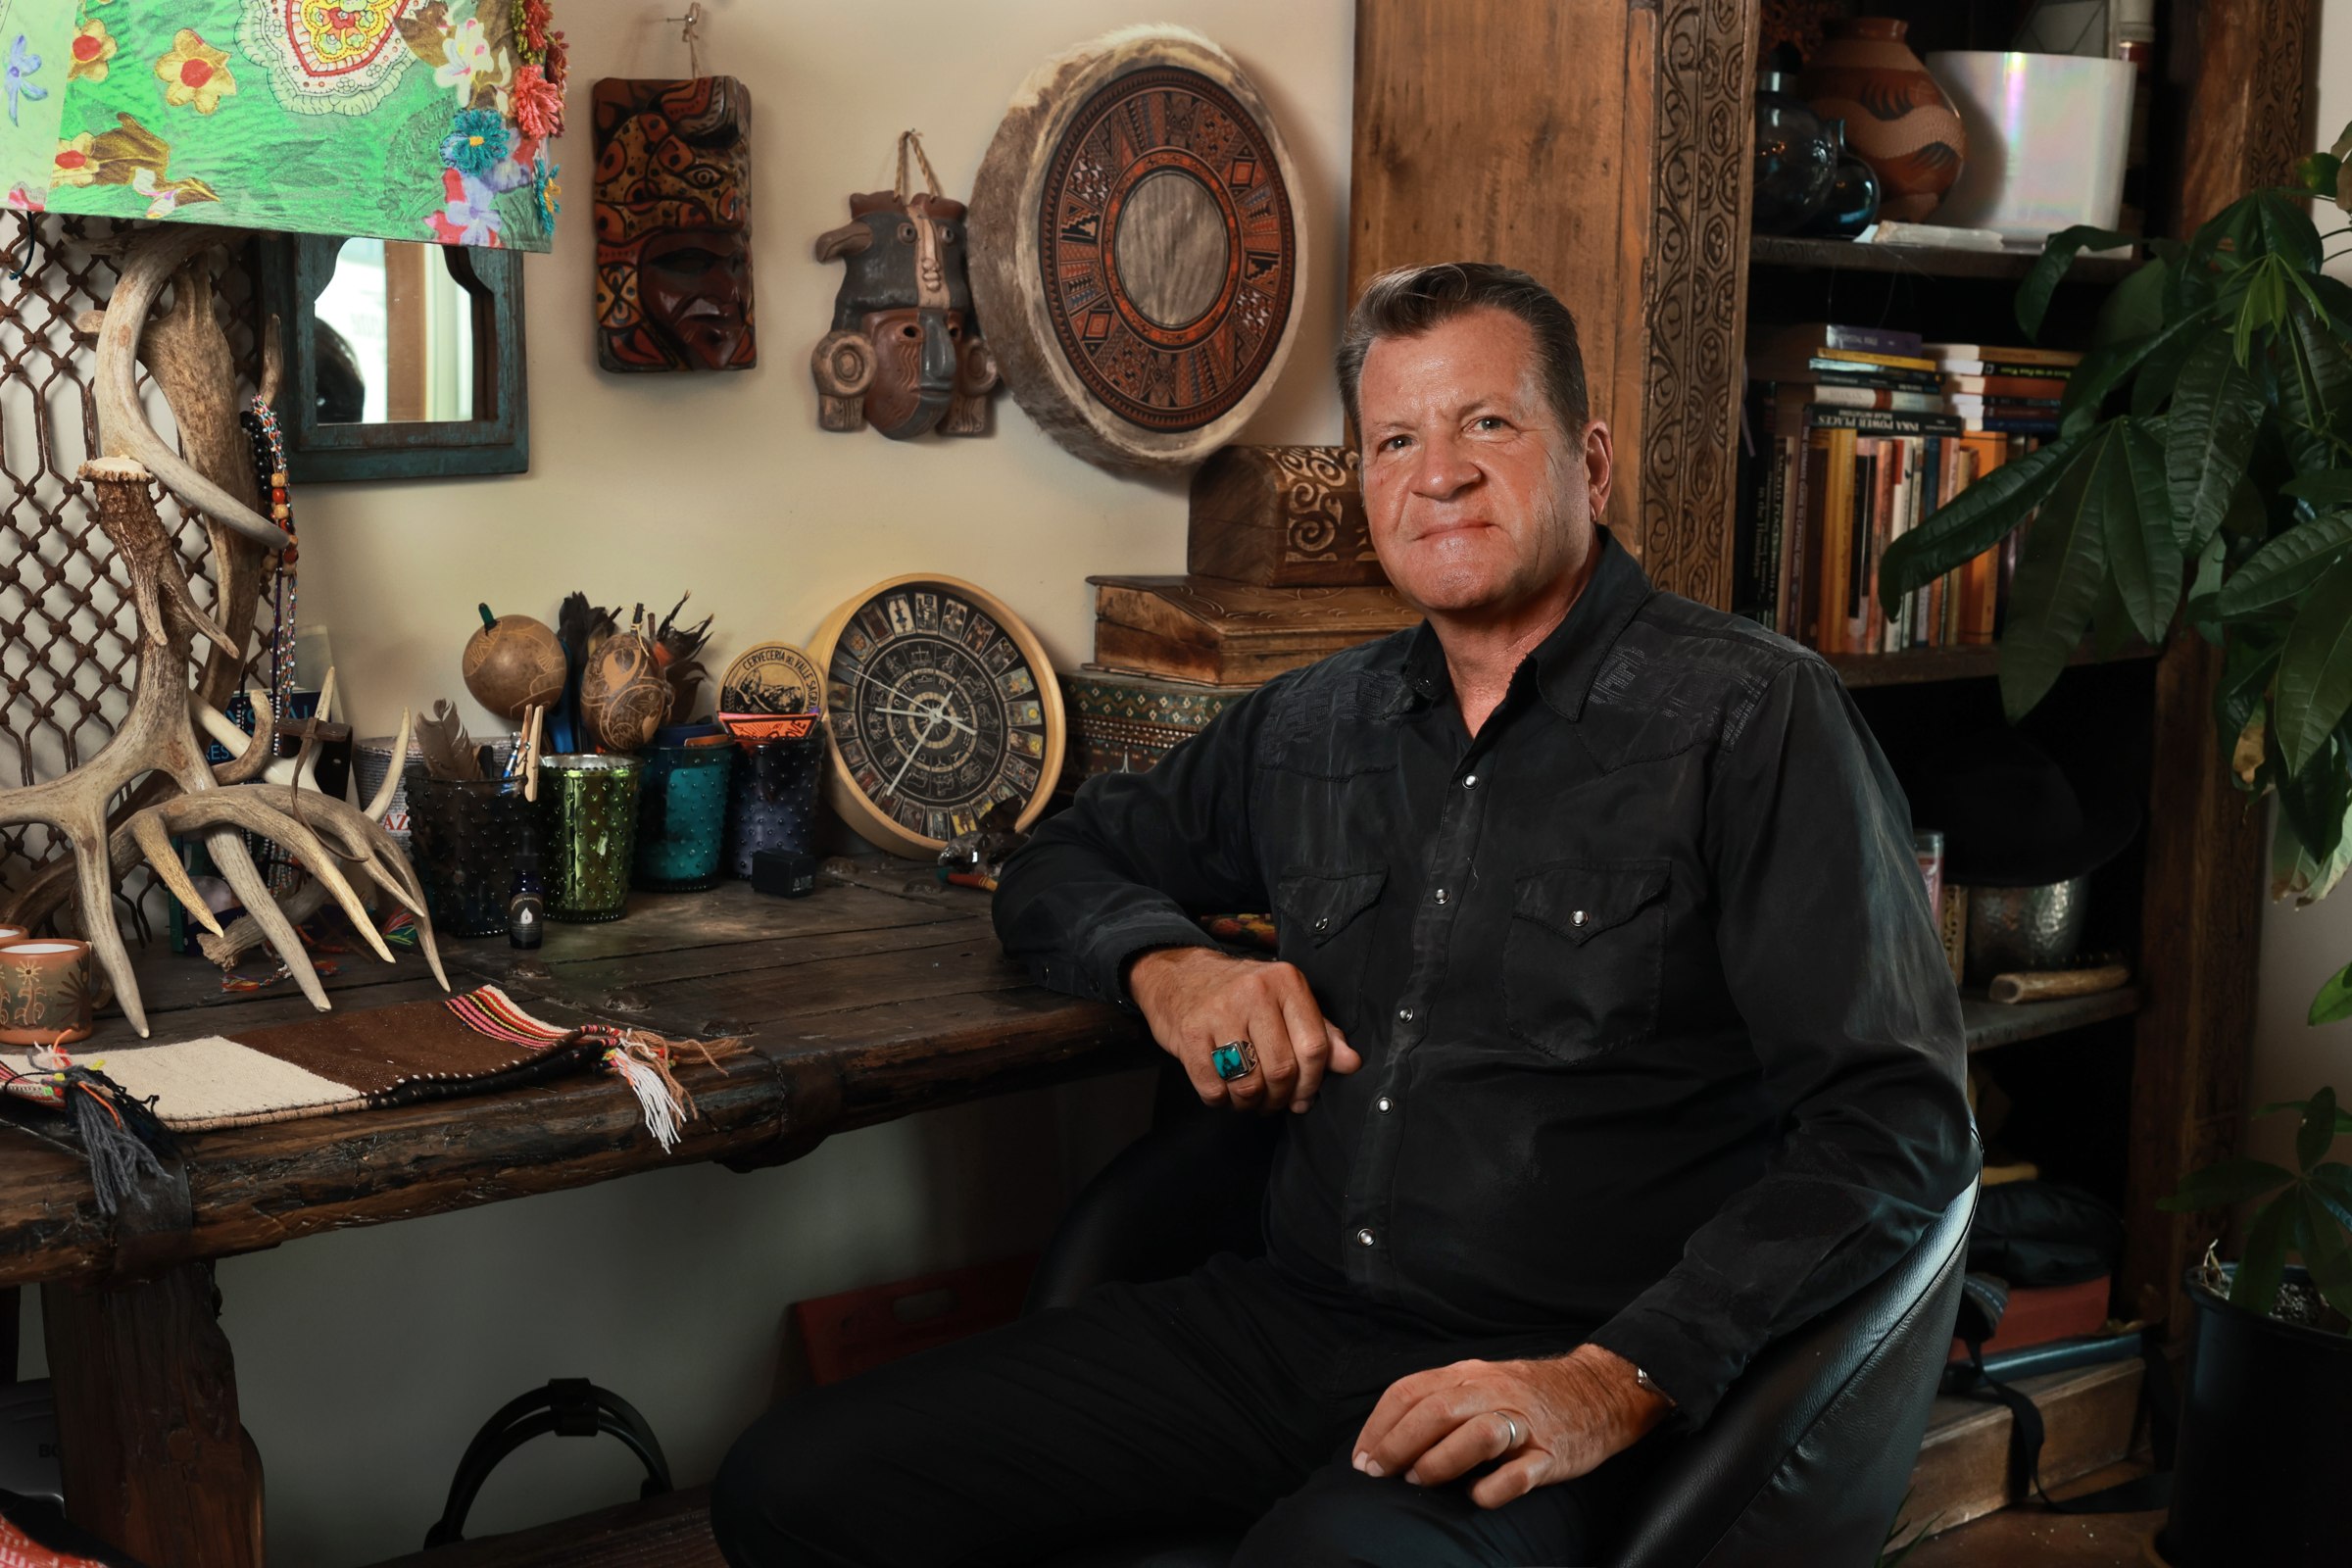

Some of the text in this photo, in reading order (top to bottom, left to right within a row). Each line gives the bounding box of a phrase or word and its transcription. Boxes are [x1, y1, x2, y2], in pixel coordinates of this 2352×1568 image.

[1818, 416, 1856, 427] PLACES
[1858, 418, 1893, 429] POWER
[1895, 420, 1919, 431] INKA
[1796, 508, 1804, 518] TO
[1794, 519, 1803, 552] CRYSTAL
[1792, 553, 1801, 578] GRIDS
[743, 650, 786, 670] CERVECERÍA
[794, 659, 813, 682] VALLE
